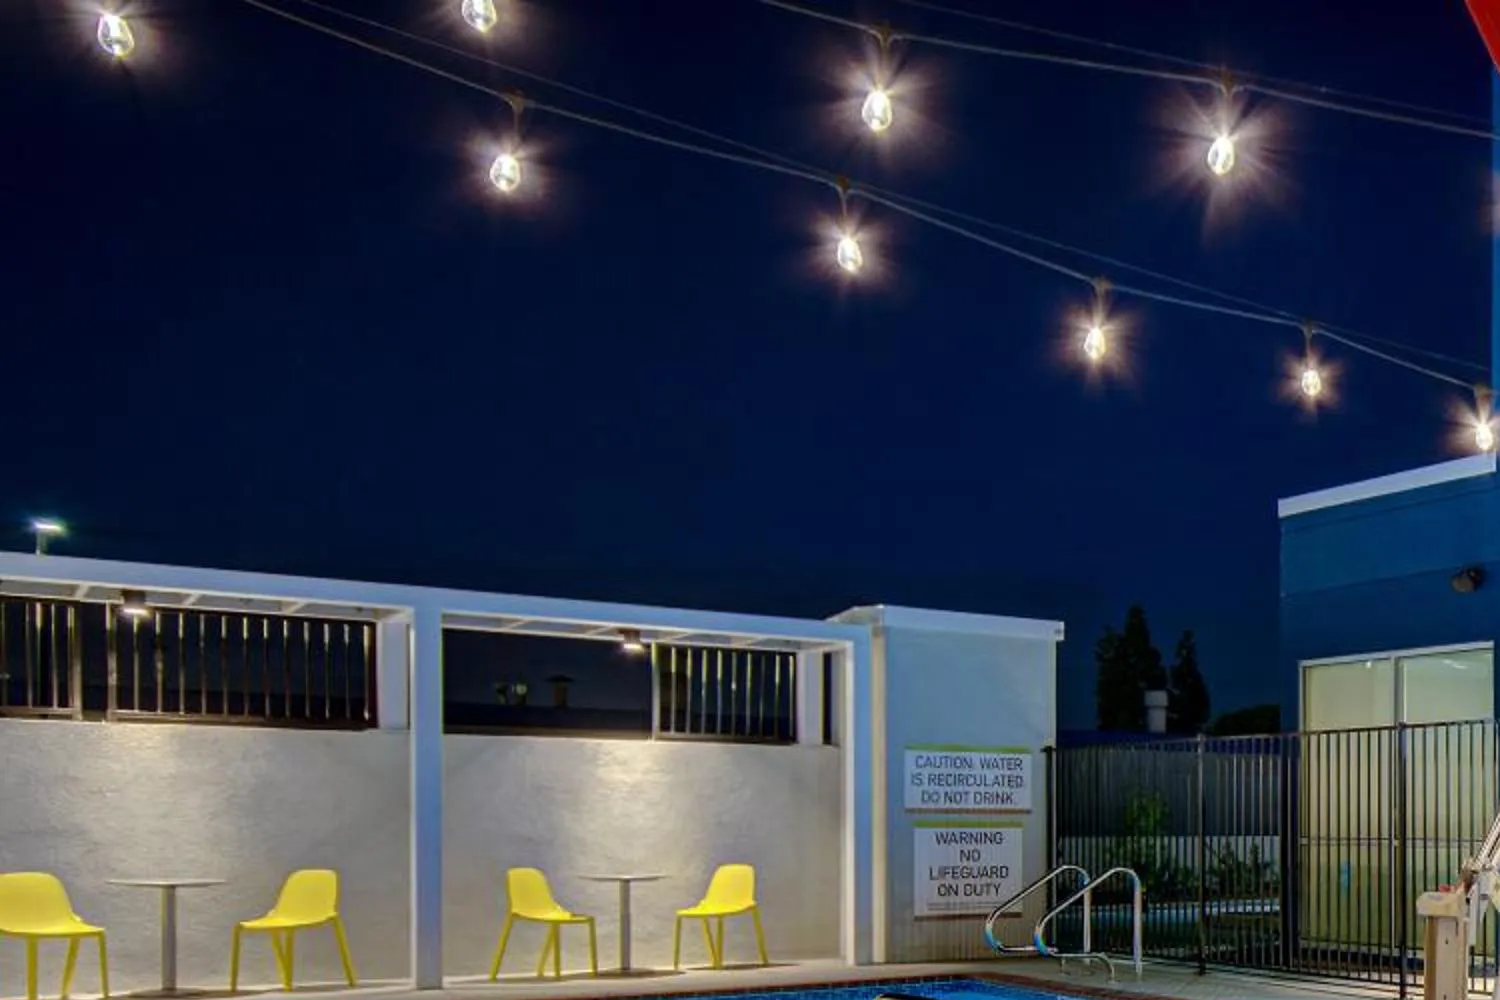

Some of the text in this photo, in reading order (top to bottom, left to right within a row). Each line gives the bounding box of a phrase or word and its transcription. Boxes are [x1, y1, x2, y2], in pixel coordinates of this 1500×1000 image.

[979, 757, 1023, 770] WATER
[911, 773, 1024, 788] IS RECIRCULATED
[921, 791, 939, 804] DO
[943, 791, 969, 804] NOT
[935, 831, 1003, 845] WARNING
[959, 849, 981, 862] NO
[929, 865, 1009, 881] LIFEGUARD
[937, 883, 1002, 897] ON DUTY
